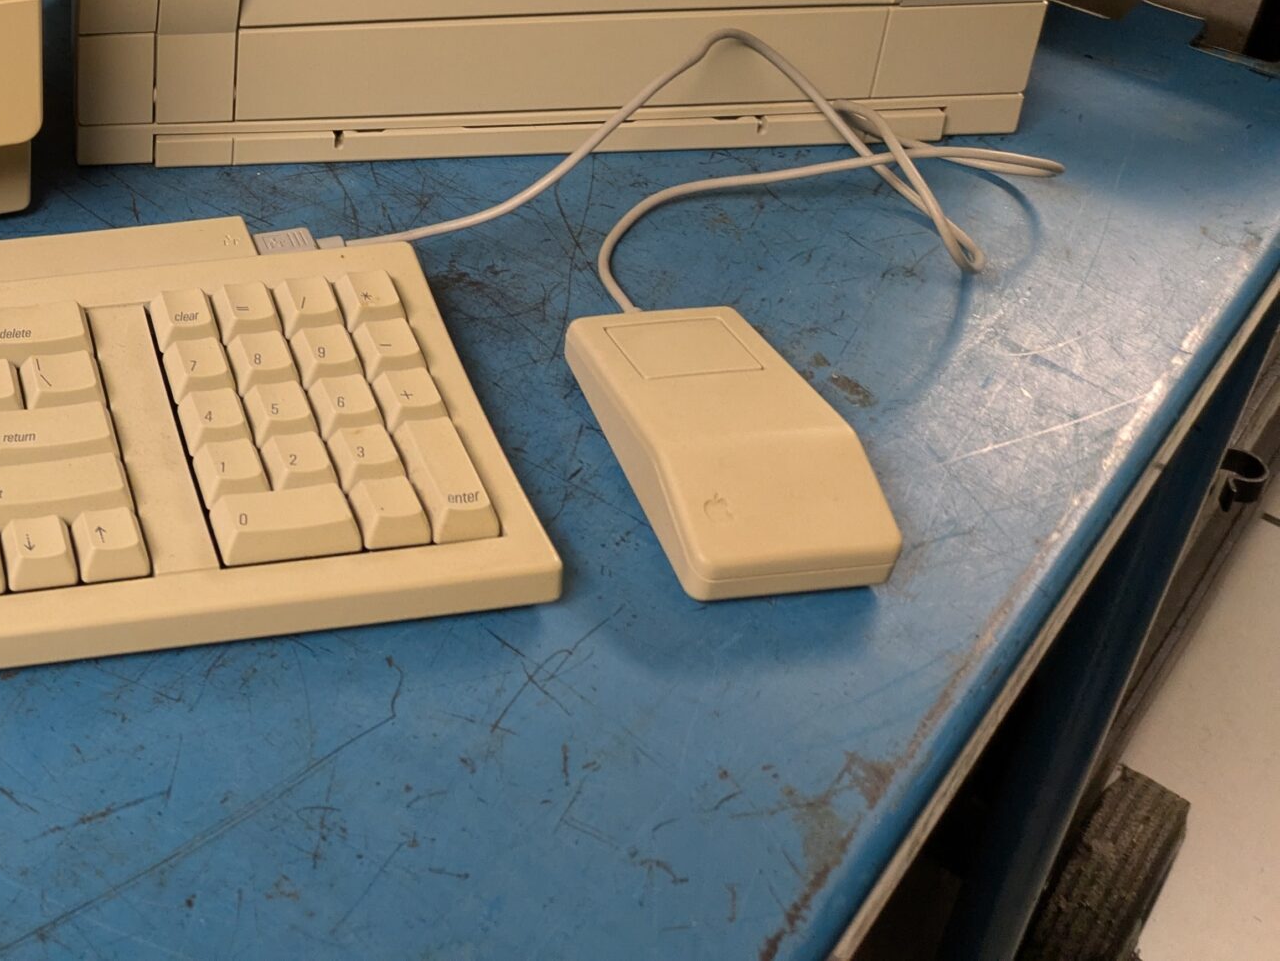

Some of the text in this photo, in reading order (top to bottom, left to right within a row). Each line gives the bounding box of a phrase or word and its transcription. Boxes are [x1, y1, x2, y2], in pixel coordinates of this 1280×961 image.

[174, 311, 199, 322] clear
[0, 328, 32, 339] delete
[317, 346, 326, 358] 9
[254, 353, 262, 365] 8
[190, 360, 197, 372] 7
[337, 396, 345, 408] 6
[271, 403, 279, 415] 5
[204, 410, 213, 422] 4
[3, 433, 36, 443] return
[356, 446, 365, 458] 3
[289, 454, 297, 466] 2
[220, 461, 226, 473] 1
[447, 491, 479, 504] enter
[239, 513, 248, 526] 0
